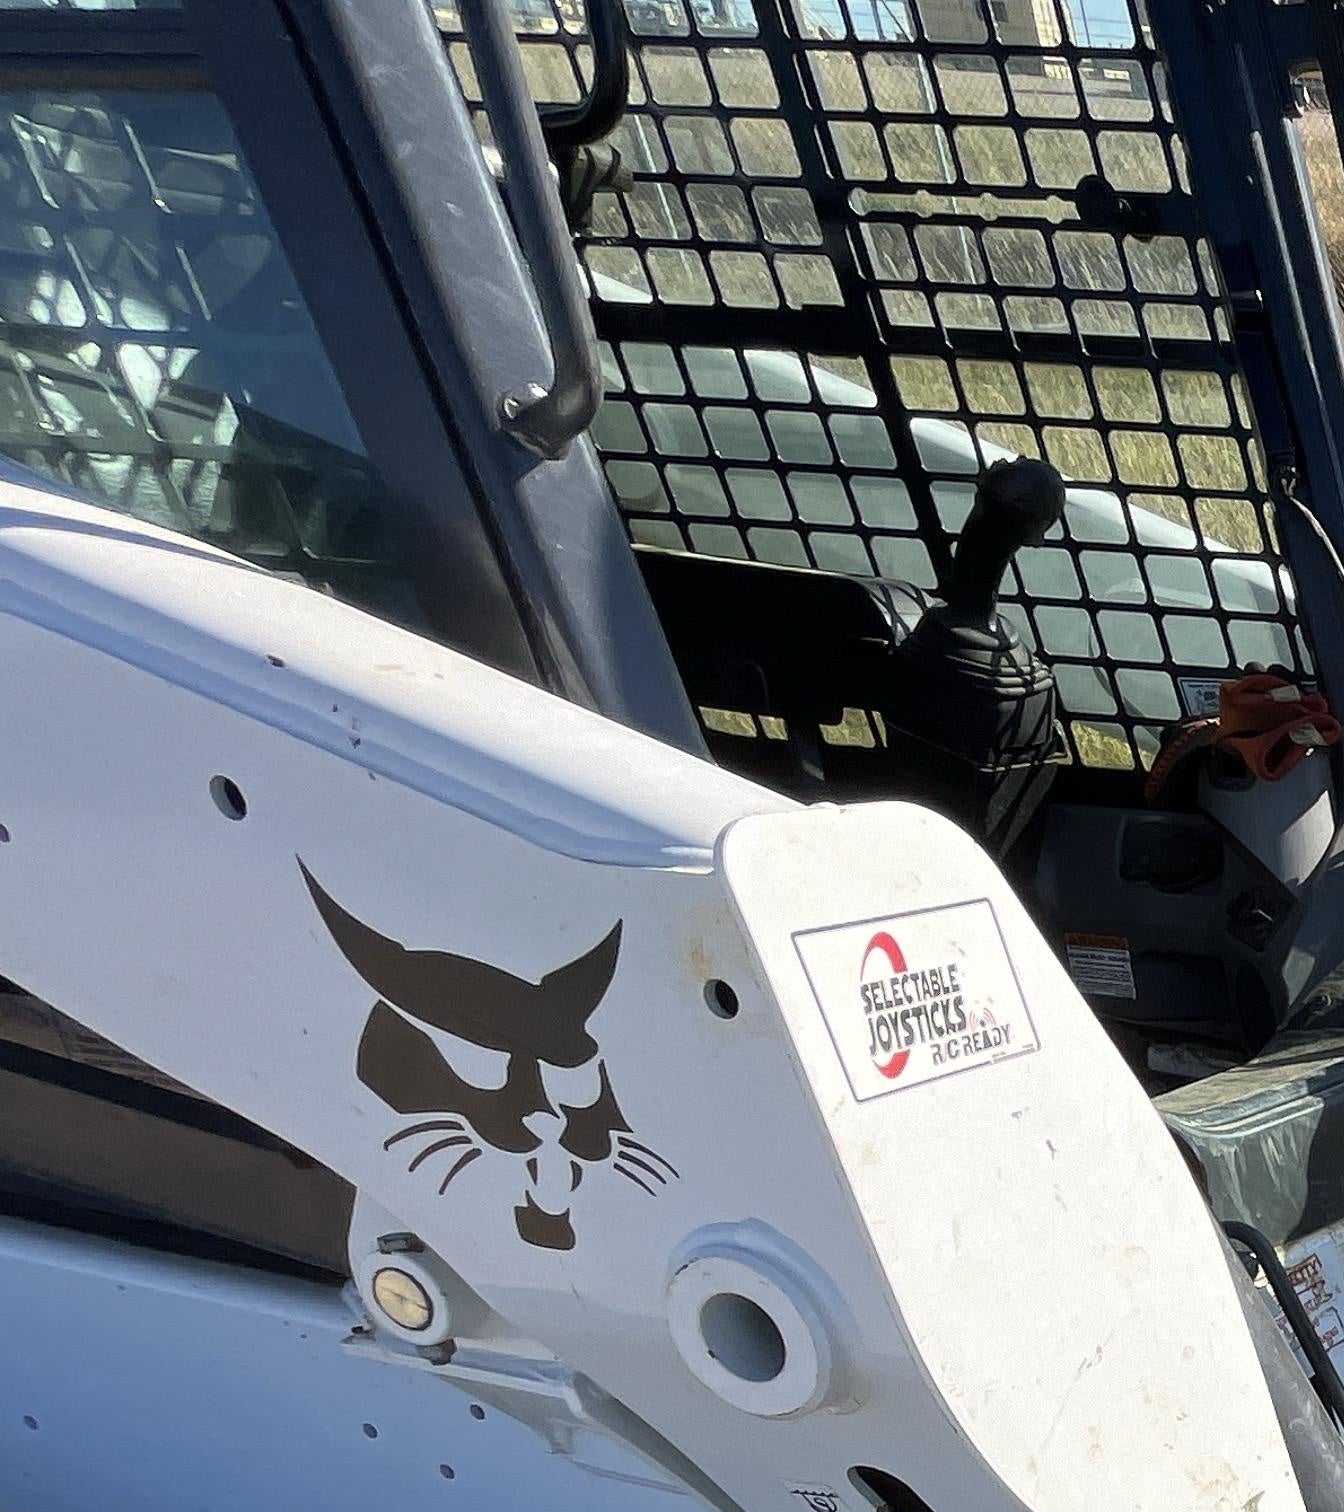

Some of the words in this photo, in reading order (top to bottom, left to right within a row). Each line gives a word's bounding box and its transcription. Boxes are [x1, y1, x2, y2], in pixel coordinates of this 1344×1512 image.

[860, 963, 961, 1014] SELECTABLE
[866, 995, 967, 1056] JOYSTICKS
[962, 1023, 1012, 1057] READY
